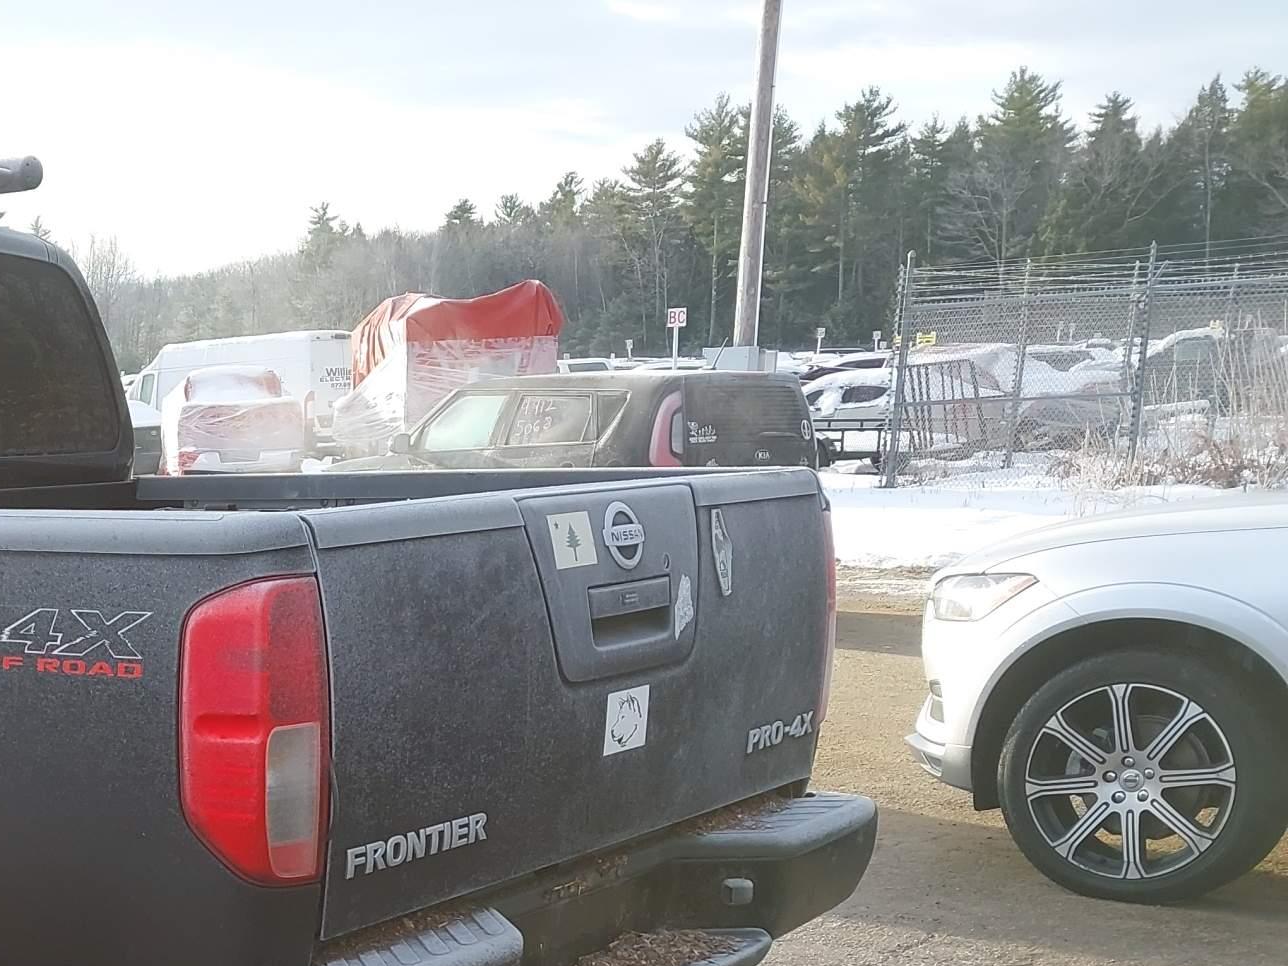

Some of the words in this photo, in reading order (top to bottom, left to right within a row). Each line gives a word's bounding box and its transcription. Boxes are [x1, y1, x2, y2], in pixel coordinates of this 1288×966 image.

[669, 310, 686, 324] BC
[611, 529, 643, 542] NISSAN
[36, 657, 143, 679] ROAD
[746, 710, 814, 754] PRO-4X
[345, 812, 488, 880] FRONTIER
